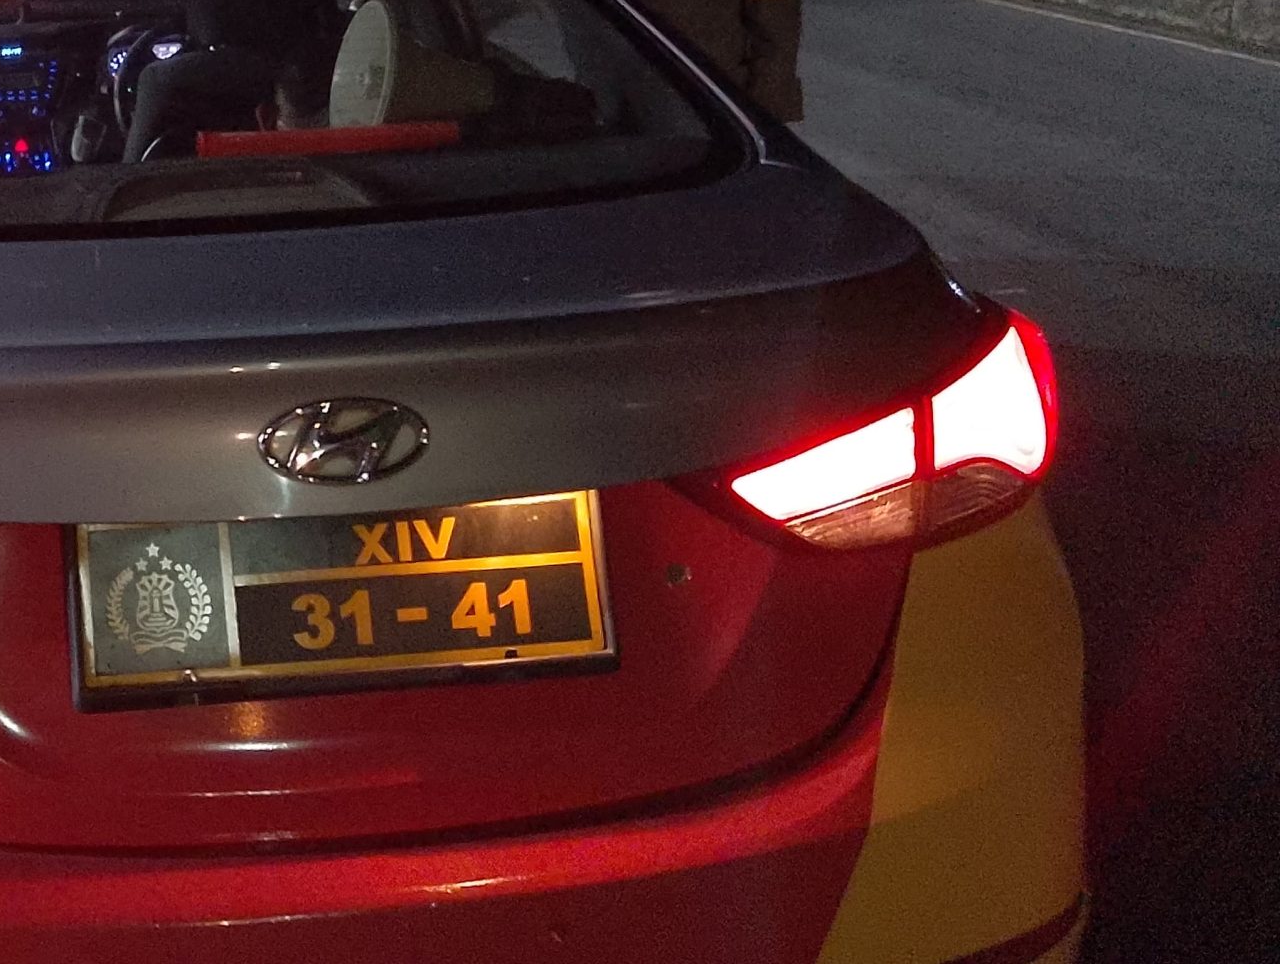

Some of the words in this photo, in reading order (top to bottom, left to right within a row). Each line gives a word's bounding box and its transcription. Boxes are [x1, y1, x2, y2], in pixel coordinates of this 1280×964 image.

[352, 516, 456, 566] XIV
[291, 589, 374, 651] 31
[450, 579, 533, 638] 41
